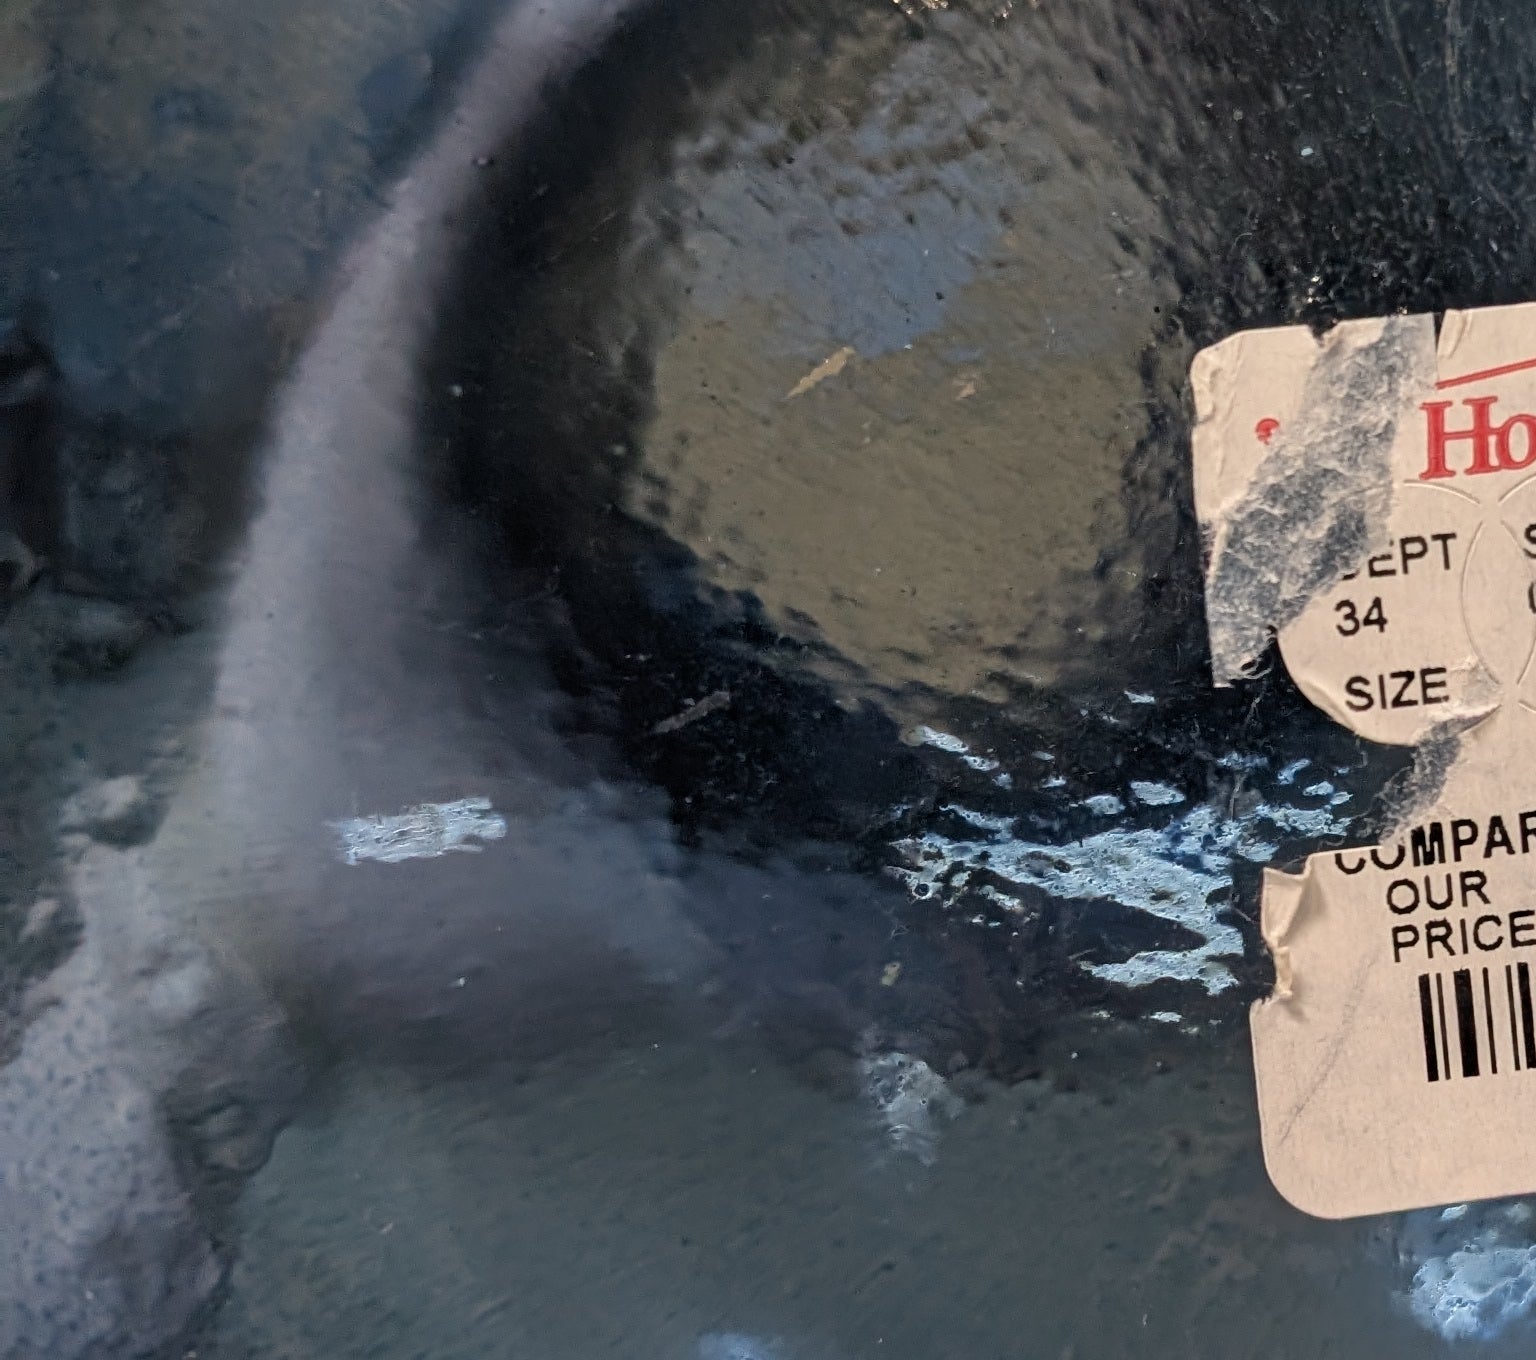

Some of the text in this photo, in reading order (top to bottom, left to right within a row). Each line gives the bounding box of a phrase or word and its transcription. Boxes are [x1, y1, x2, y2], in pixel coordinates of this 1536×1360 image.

[1341, 533, 1457, 581] EPT
[1335, 597, 1388, 637] 34
[1345, 668, 1449, 711] SIZE
[1387, 870, 1491, 915] OUR
